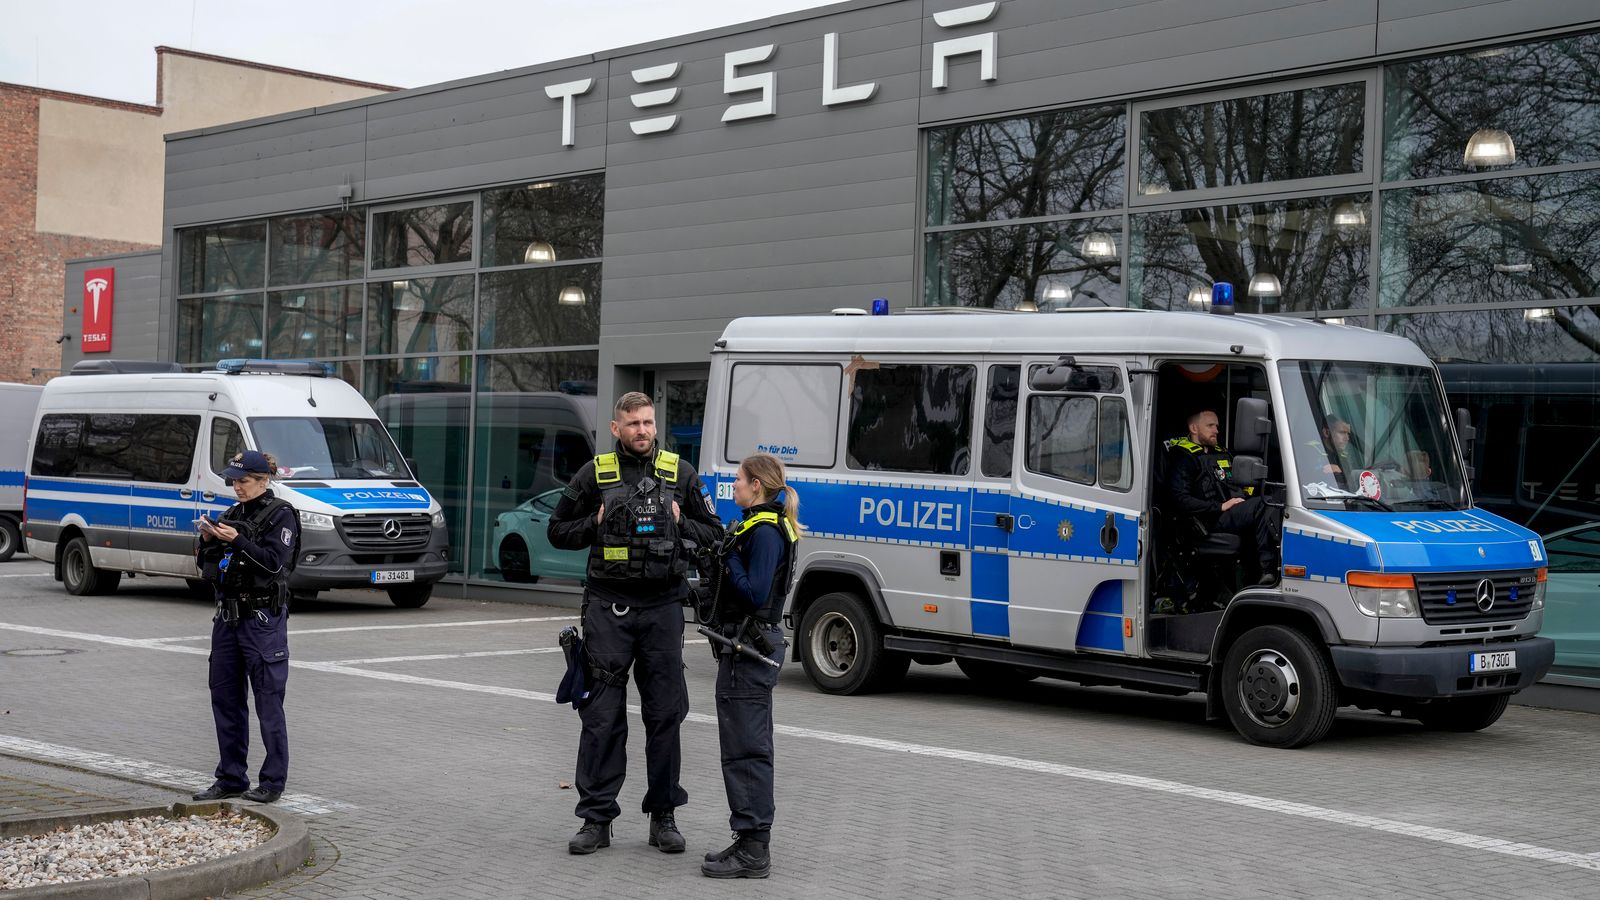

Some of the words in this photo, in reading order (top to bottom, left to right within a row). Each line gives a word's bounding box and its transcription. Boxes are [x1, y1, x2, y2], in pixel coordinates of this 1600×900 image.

[544, 1, 1000, 147] TESLA
[83, 333, 107, 342] TESLA
[769, 445, 780, 454] für
[780, 446, 798, 455] Dich
[342, 491, 411, 501] POLIZEI
[859, 497, 962, 532] POLIZEI
[147, 515, 177, 529] POLIZEI
[1390, 519, 1499, 534] POLIZEI
[376, 572, 381, 581] B
[387, 571, 409, 580] 31481
[1480, 655, 1487, 669] B
[1491, 653, 1510, 668] 7300
